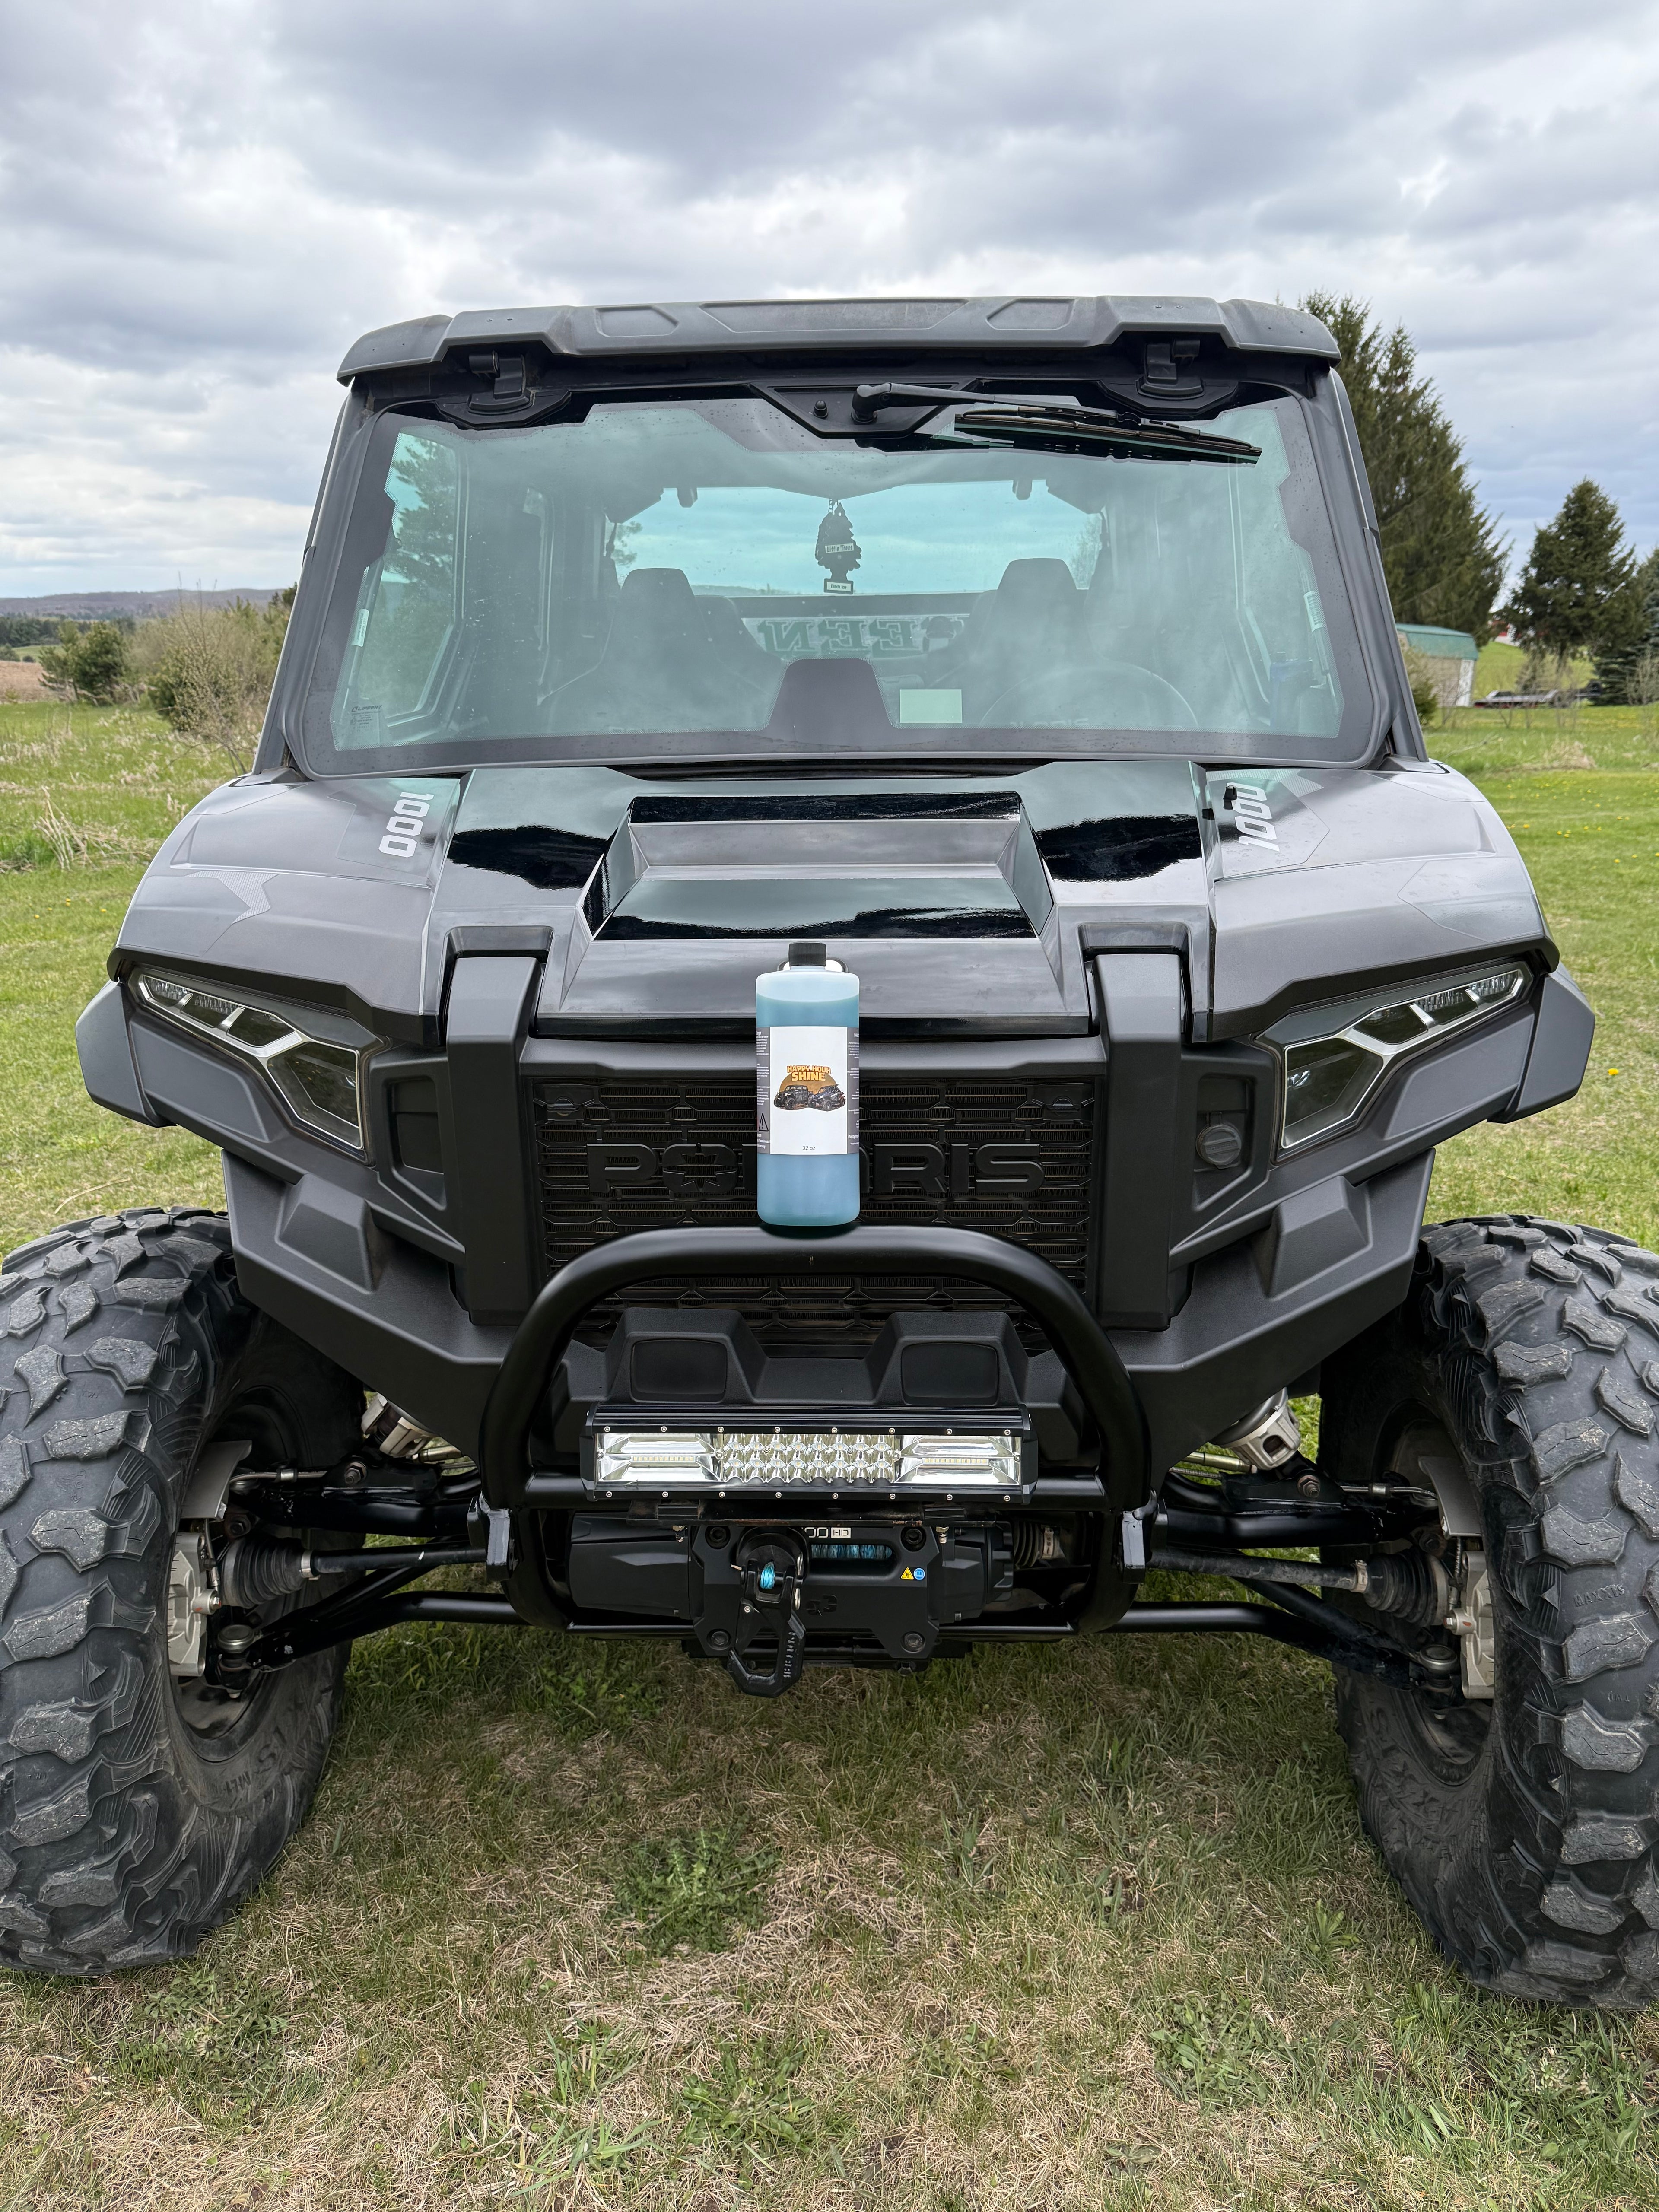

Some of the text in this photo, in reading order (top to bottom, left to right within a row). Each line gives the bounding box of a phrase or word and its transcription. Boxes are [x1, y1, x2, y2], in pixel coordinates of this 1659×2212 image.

[378, 792, 434, 858] 1000
[791, 1071, 826, 1081] SHINE
[812, 1065, 831, 1074] HOUR
[586, 1143, 1046, 1193] PORIS
[1573, 1583, 1625, 1607] MAXXIS
